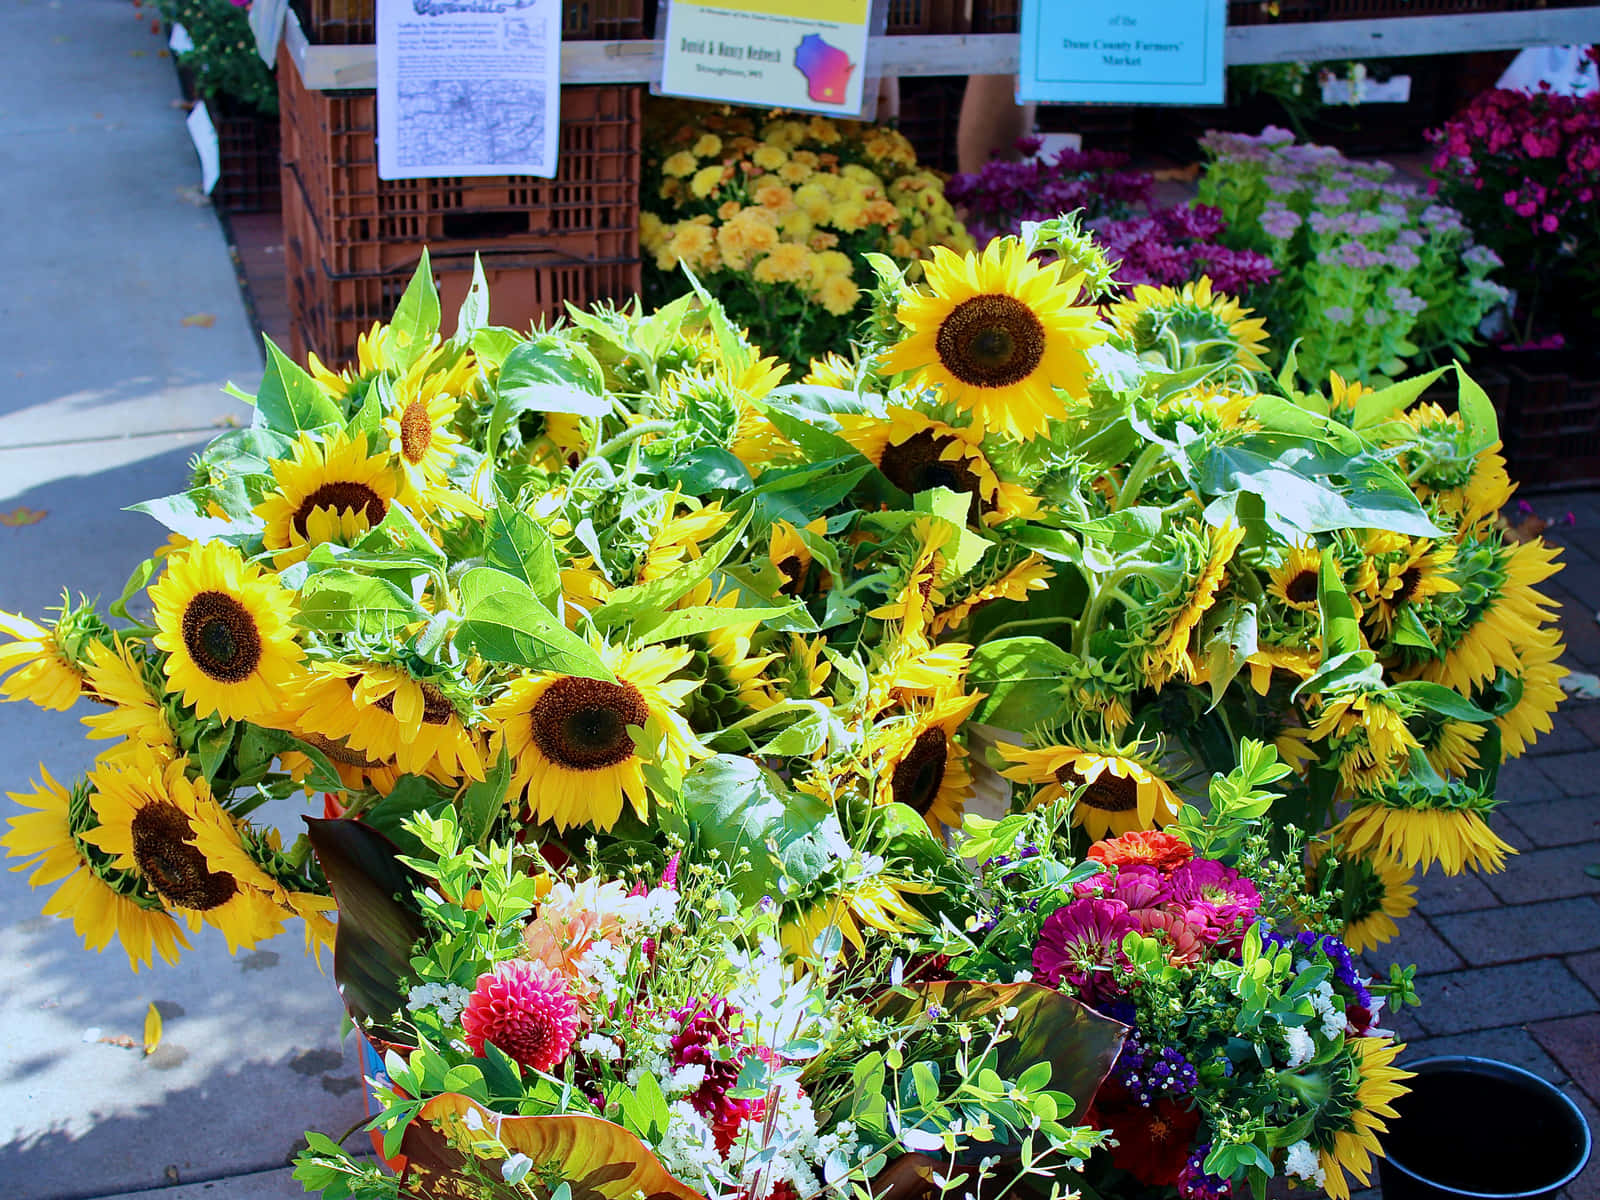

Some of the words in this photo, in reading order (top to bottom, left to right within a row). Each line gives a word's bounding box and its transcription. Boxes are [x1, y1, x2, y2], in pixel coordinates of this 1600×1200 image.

[1108, 14, 1120, 26] of
[1122, 14, 1137, 27] the
[1062, 38, 1090, 50] Dane
[1093, 39, 1132, 53] County
[1102, 55, 1142, 67] Market
